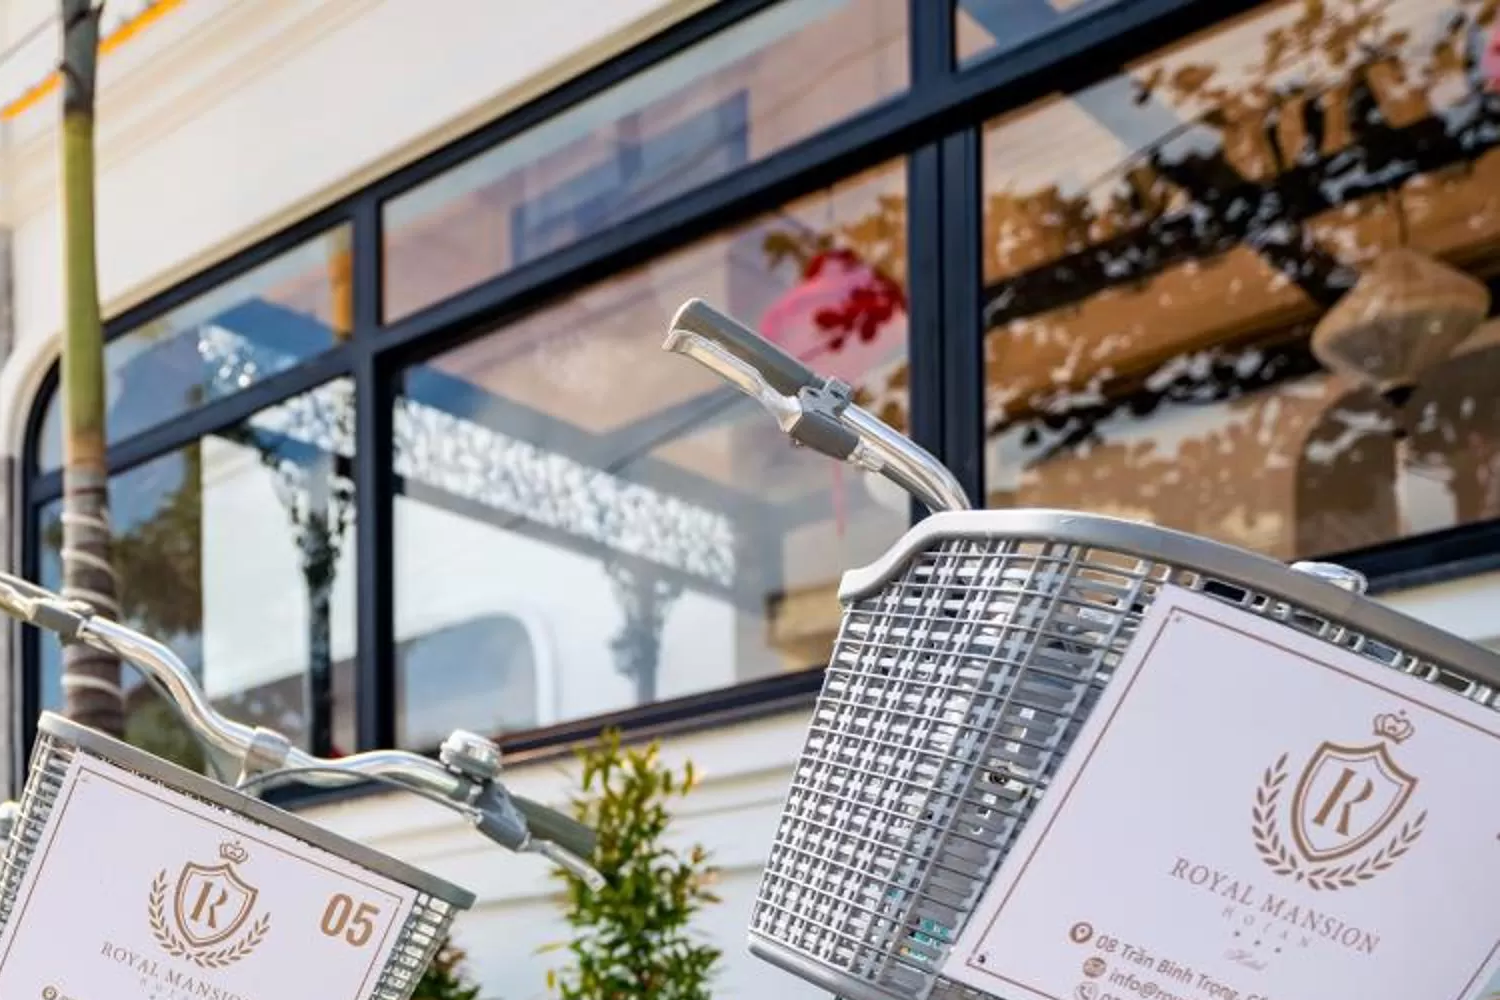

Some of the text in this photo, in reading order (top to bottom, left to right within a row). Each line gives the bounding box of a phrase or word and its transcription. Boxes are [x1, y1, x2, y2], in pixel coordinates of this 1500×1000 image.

[321, 893, 380, 947] 05
[1170, 857, 1381, 954] ROYAL MANSION
[100, 940, 158, 977] ROYAL
[1096, 935, 1119, 952] 08
